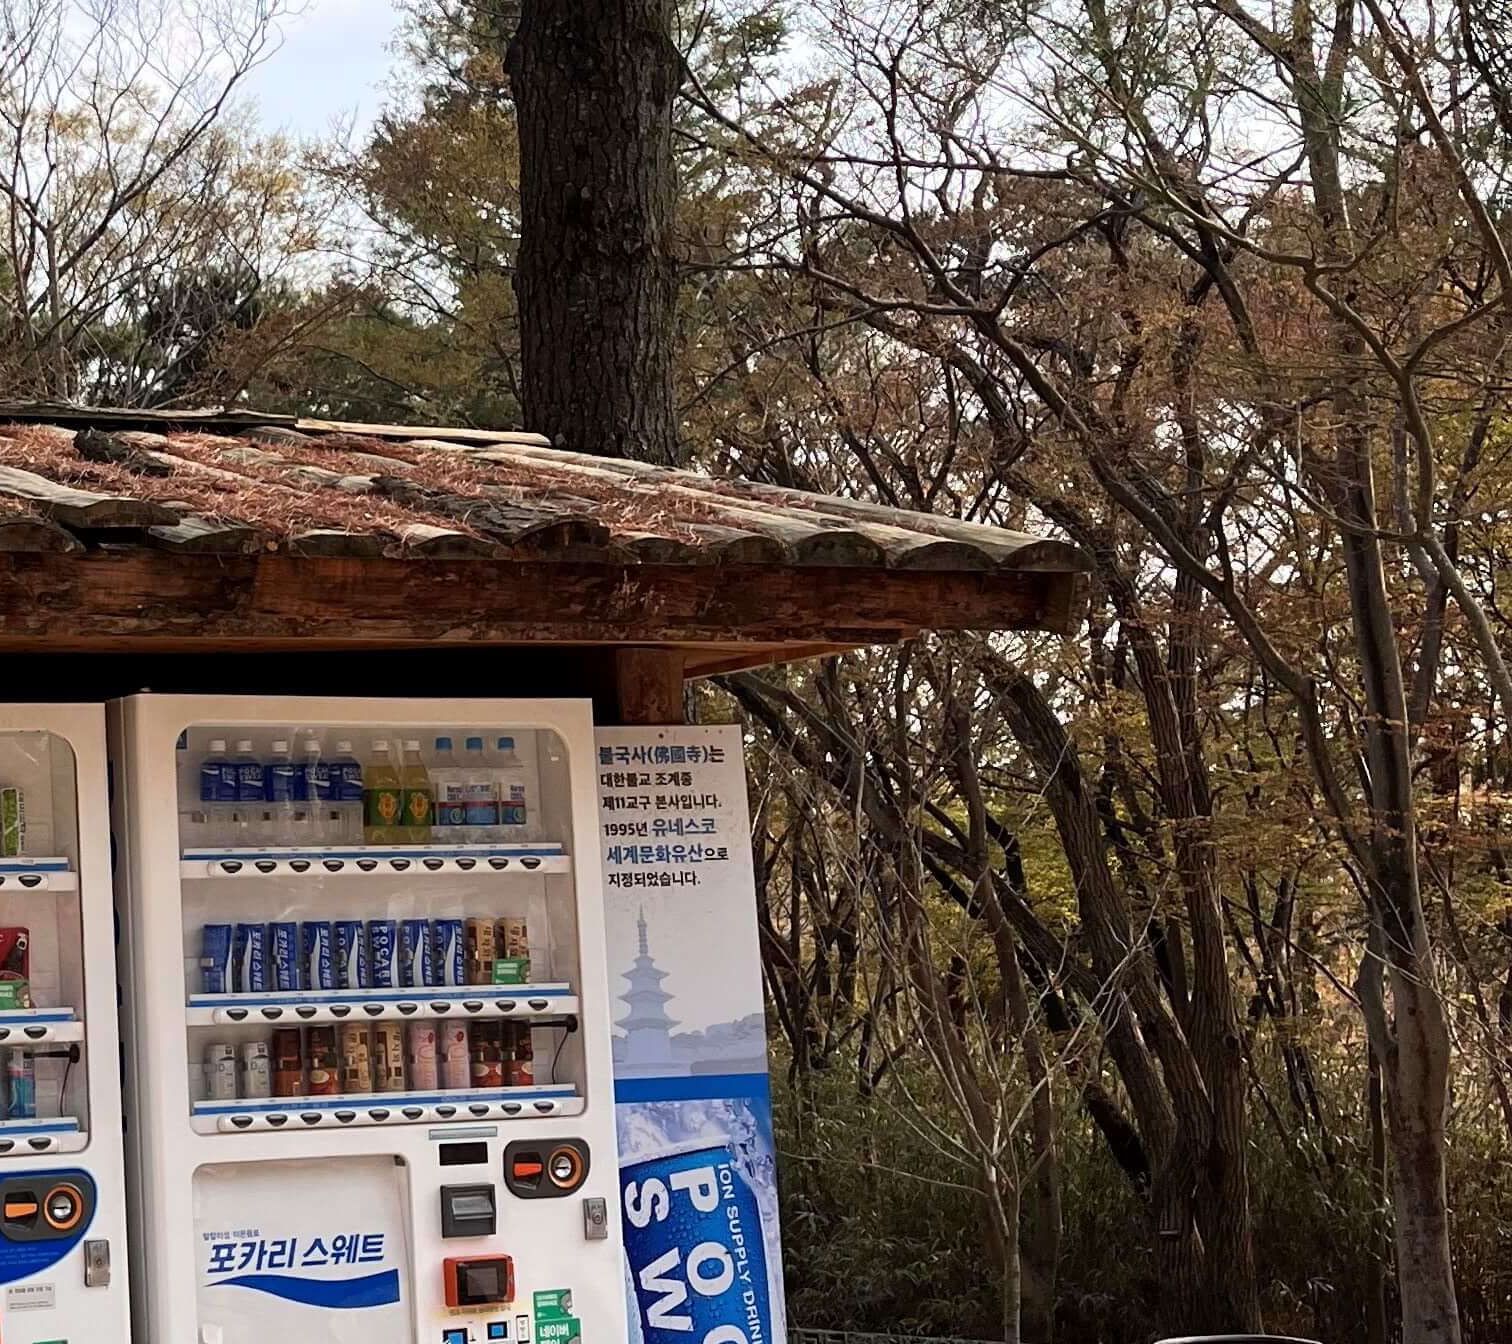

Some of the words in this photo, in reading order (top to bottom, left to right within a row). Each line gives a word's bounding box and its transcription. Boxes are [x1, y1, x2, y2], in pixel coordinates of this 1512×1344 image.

[598, 745, 725, 765] 불국사(佛國寺)는
[600, 772, 652, 787] 대한불교
[655, 772, 693, 787] 조계종
[602, 796, 652, 811] 제11교구
[655, 794, 722, 810] 본사입니다.
[604, 821, 648, 838] 1995년
[652, 818, 717, 838] 유네스코
[606, 845, 729, 865] 세계문화유산으로
[608, 871, 701, 888] 지정되었습니다.
[380, 926, 390, 985] POCARI
[717, 1163, 735, 1199] ION
[726, 1206, 752, 1284] SUPPLY
